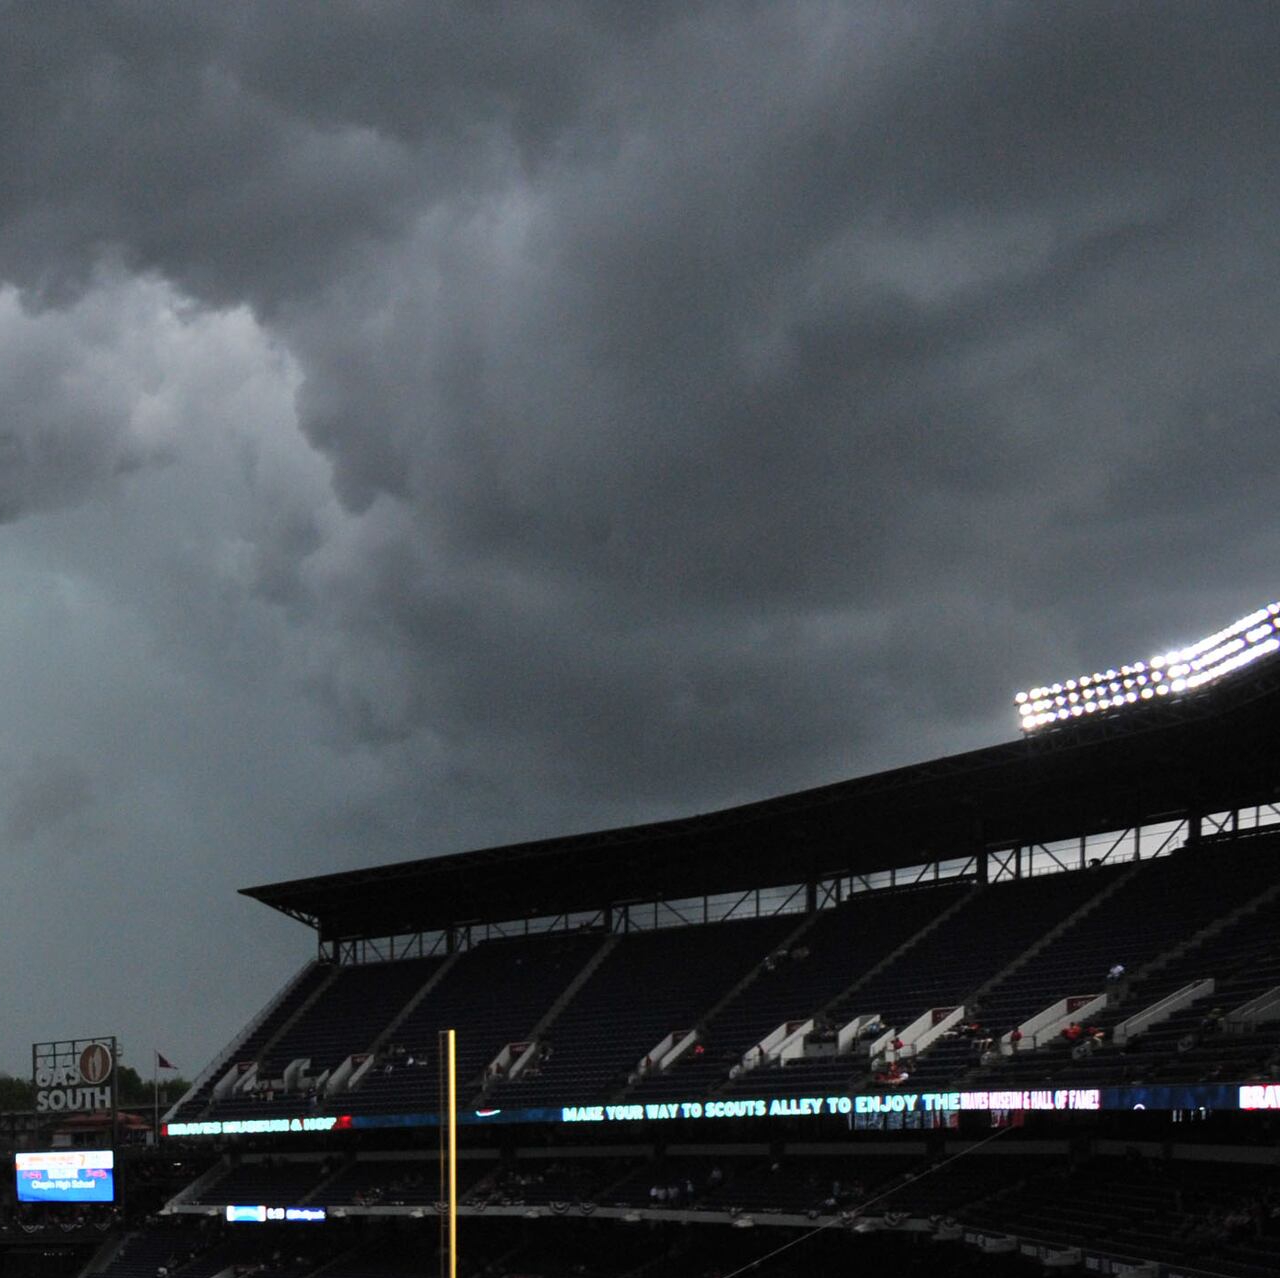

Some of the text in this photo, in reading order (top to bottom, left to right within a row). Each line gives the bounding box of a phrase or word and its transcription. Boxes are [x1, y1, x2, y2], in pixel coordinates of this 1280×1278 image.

[36, 1060, 80, 1087] GAS
[36, 1087, 111, 1111] SOUTH
[562, 1092, 960, 1122] MAKE YOUR WAY TO SCOUTS ALLEY TO ENJOY THE
[960, 1090, 1100, 1110] BRAVES MUSEUM HALL OF FAME!
[167, 1117, 337, 1136] BRAVES MUSEUM & HOF
